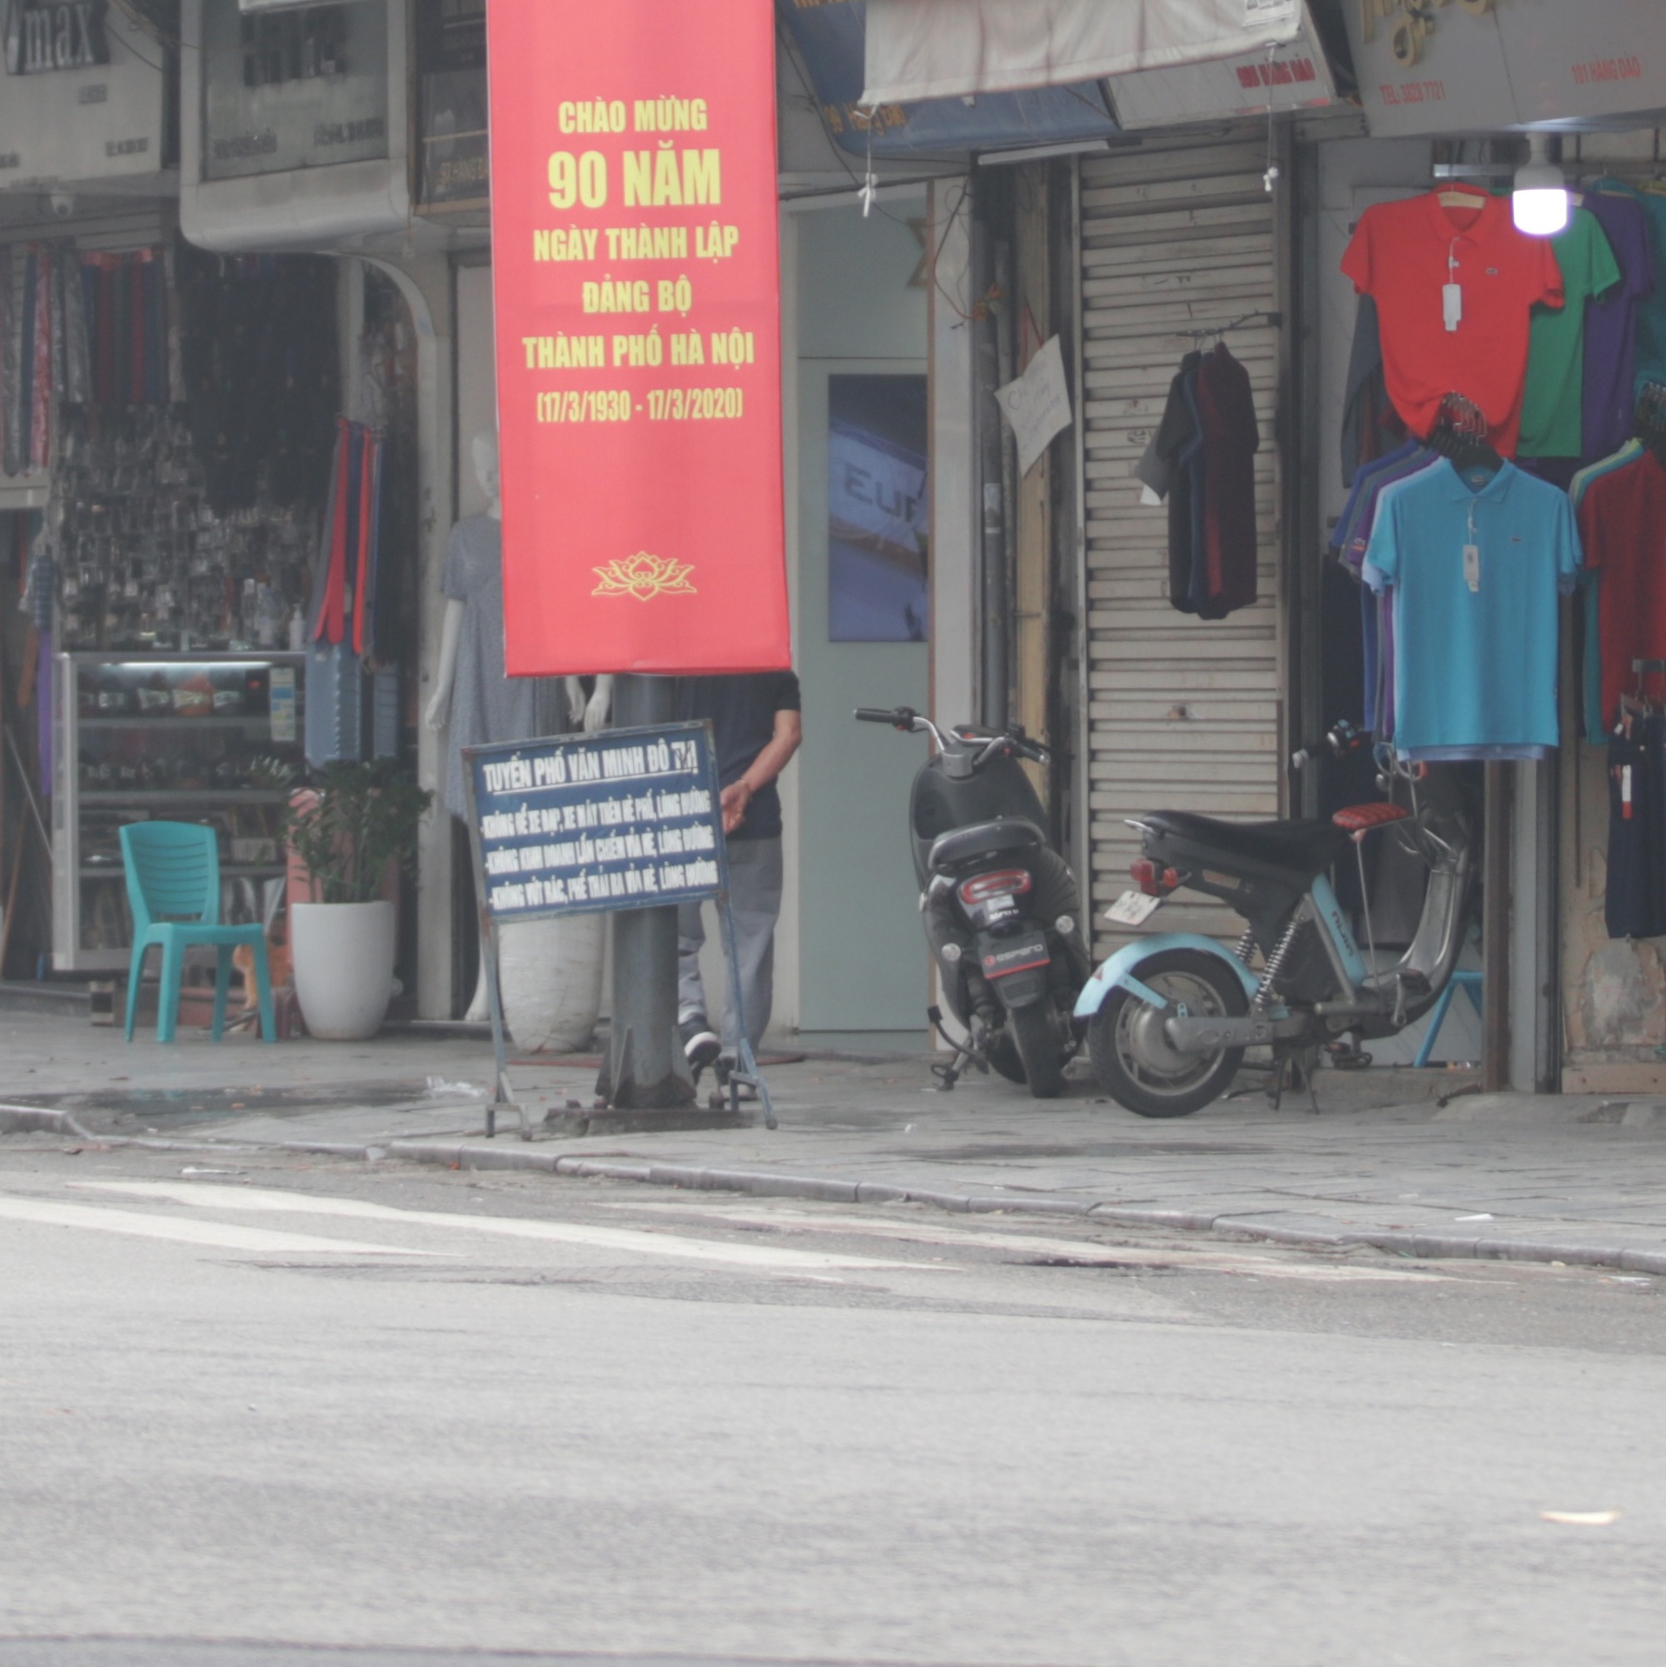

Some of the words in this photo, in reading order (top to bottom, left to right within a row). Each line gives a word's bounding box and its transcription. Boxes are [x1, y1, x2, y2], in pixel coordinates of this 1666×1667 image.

[1571, 63, 1588, 85] 101
[558, 95, 626, 134] CHÀO
[634, 94, 708, 132] MỪNG
[547, 150, 608, 210] 90
[623, 140, 721, 207] NĂM
[533, 224, 599, 262] NGÀY
[605, 222, 688, 260] THÀNH
[695, 220, 740, 264] LẬP
[582, 273, 650, 314] ĐẢNG
[657, 274, 692, 318] BỘ
[522, 331, 605, 369] THÀNH
[613, 324, 662, 367] PHỐ
[671, 328, 704, 365] HÀ
[711, 326, 754, 370] NỘI
[537, 390, 631, 422] (17/3/1930
[646, 387, 743, 420] 17/3/2020)
[483, 751, 532, 793] TUYẾN
[534, 746, 566, 786] PHỐ
[568, 746, 600, 782] VĂN
[602, 745, 645, 778] MINH
[647, 737, 670, 773] ĐÔ
